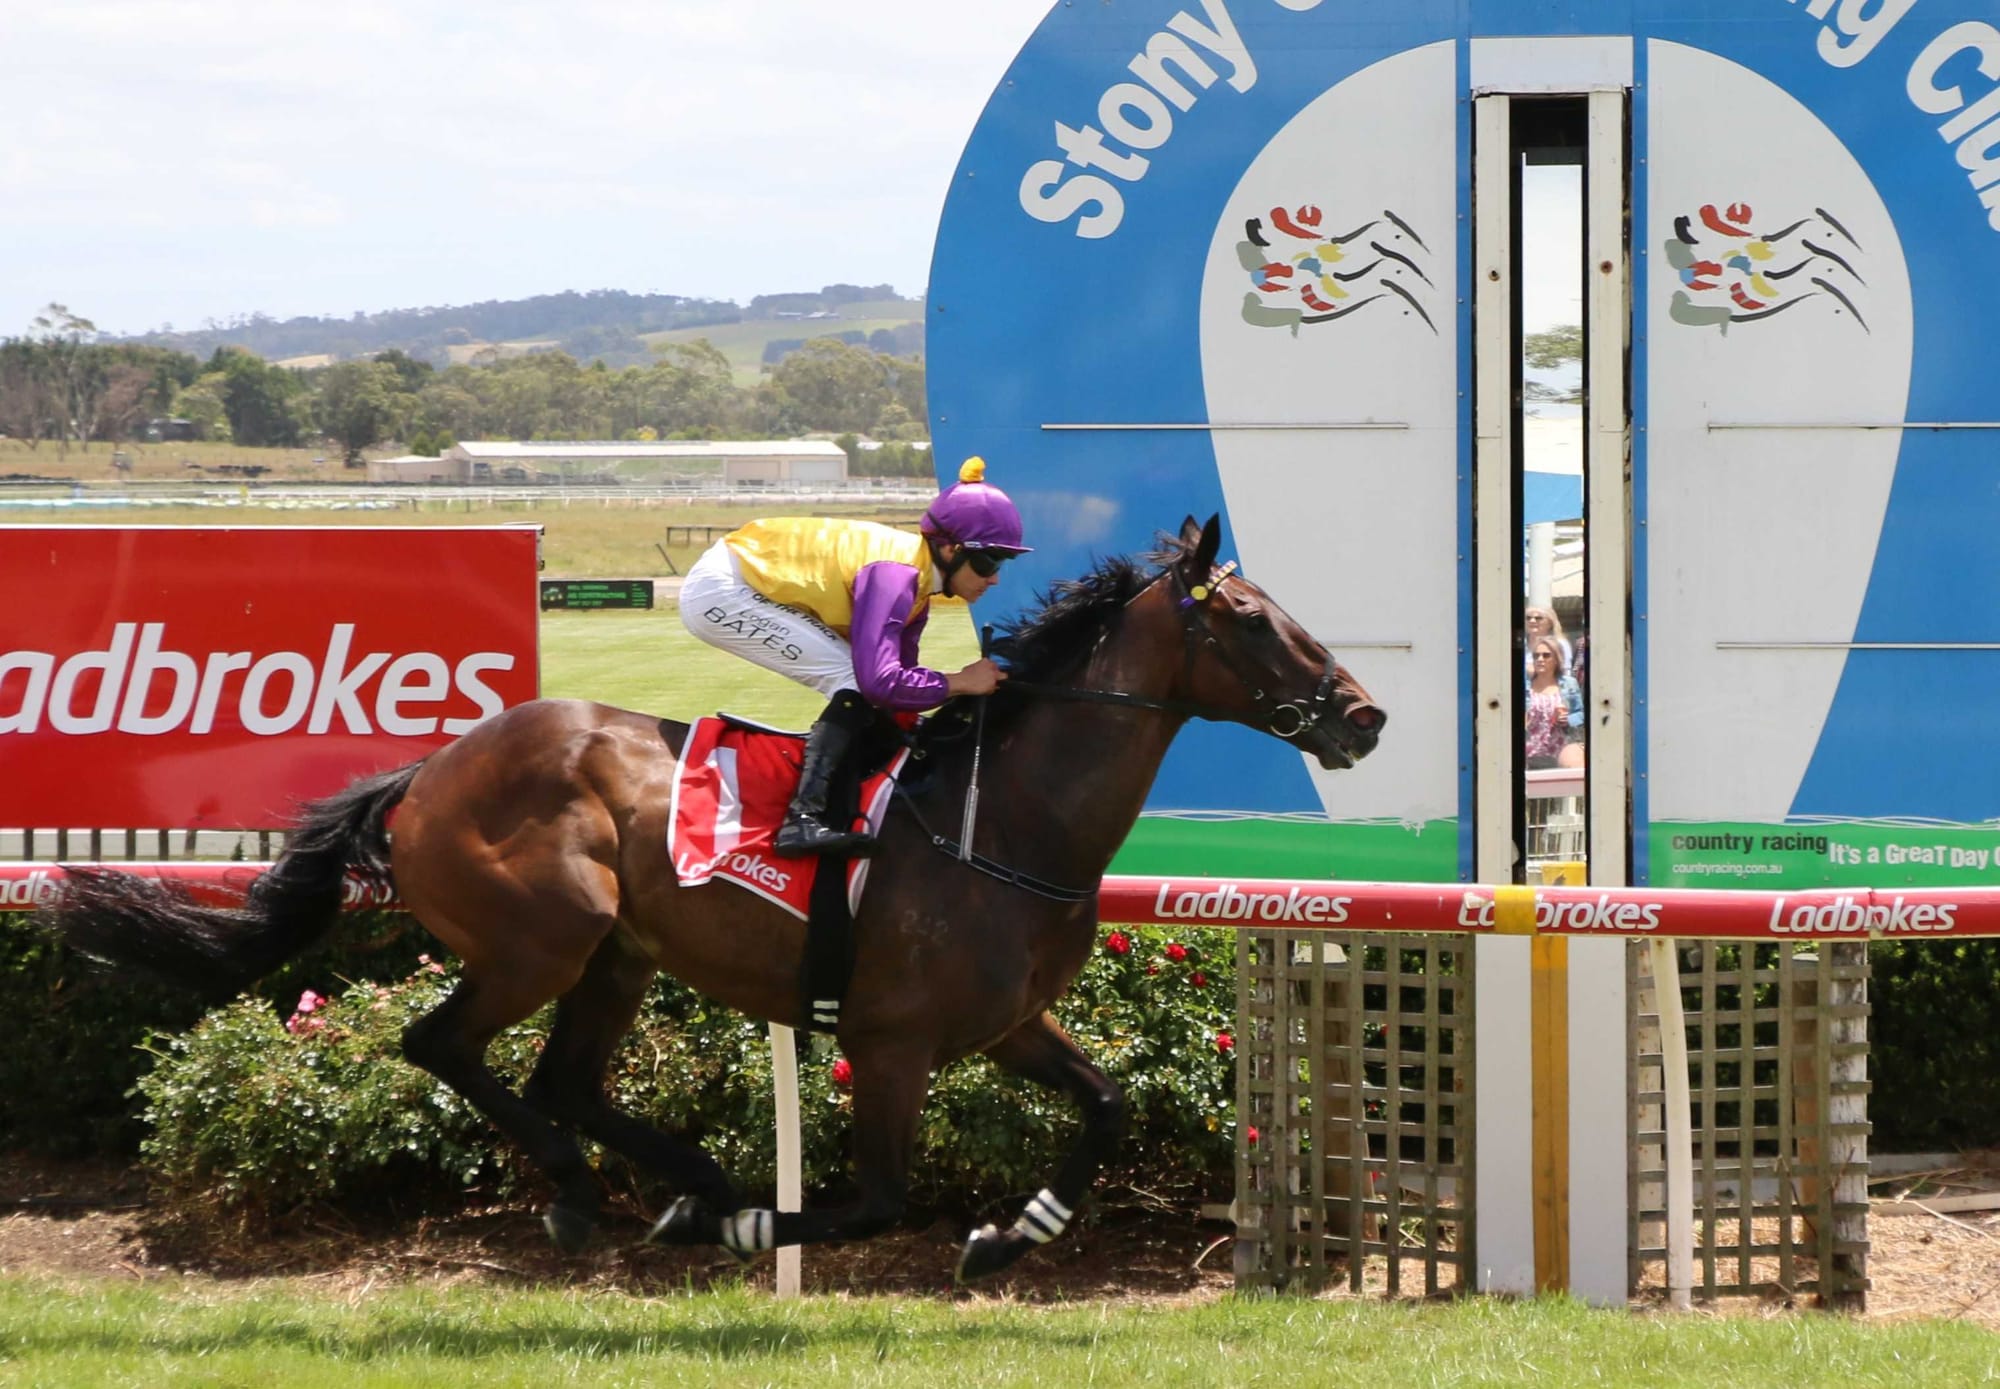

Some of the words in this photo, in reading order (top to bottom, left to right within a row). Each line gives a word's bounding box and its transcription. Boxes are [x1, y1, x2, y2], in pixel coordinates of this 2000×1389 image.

[1019, 0, 1257, 239] Stony
[703, 606, 803, 661] BATES
[738, 609, 791, 636] Logan
[1672, 832, 1754, 854] country
[1761, 831, 1828, 855] racing
[1829, 842, 1861, 865] It's
[1867, 846, 1880, 864] a
[1951, 847, 1989, 870] Day
[1154, 883, 1352, 923] Ladbrokes
[1457, 892, 1663, 930] Labrokes
